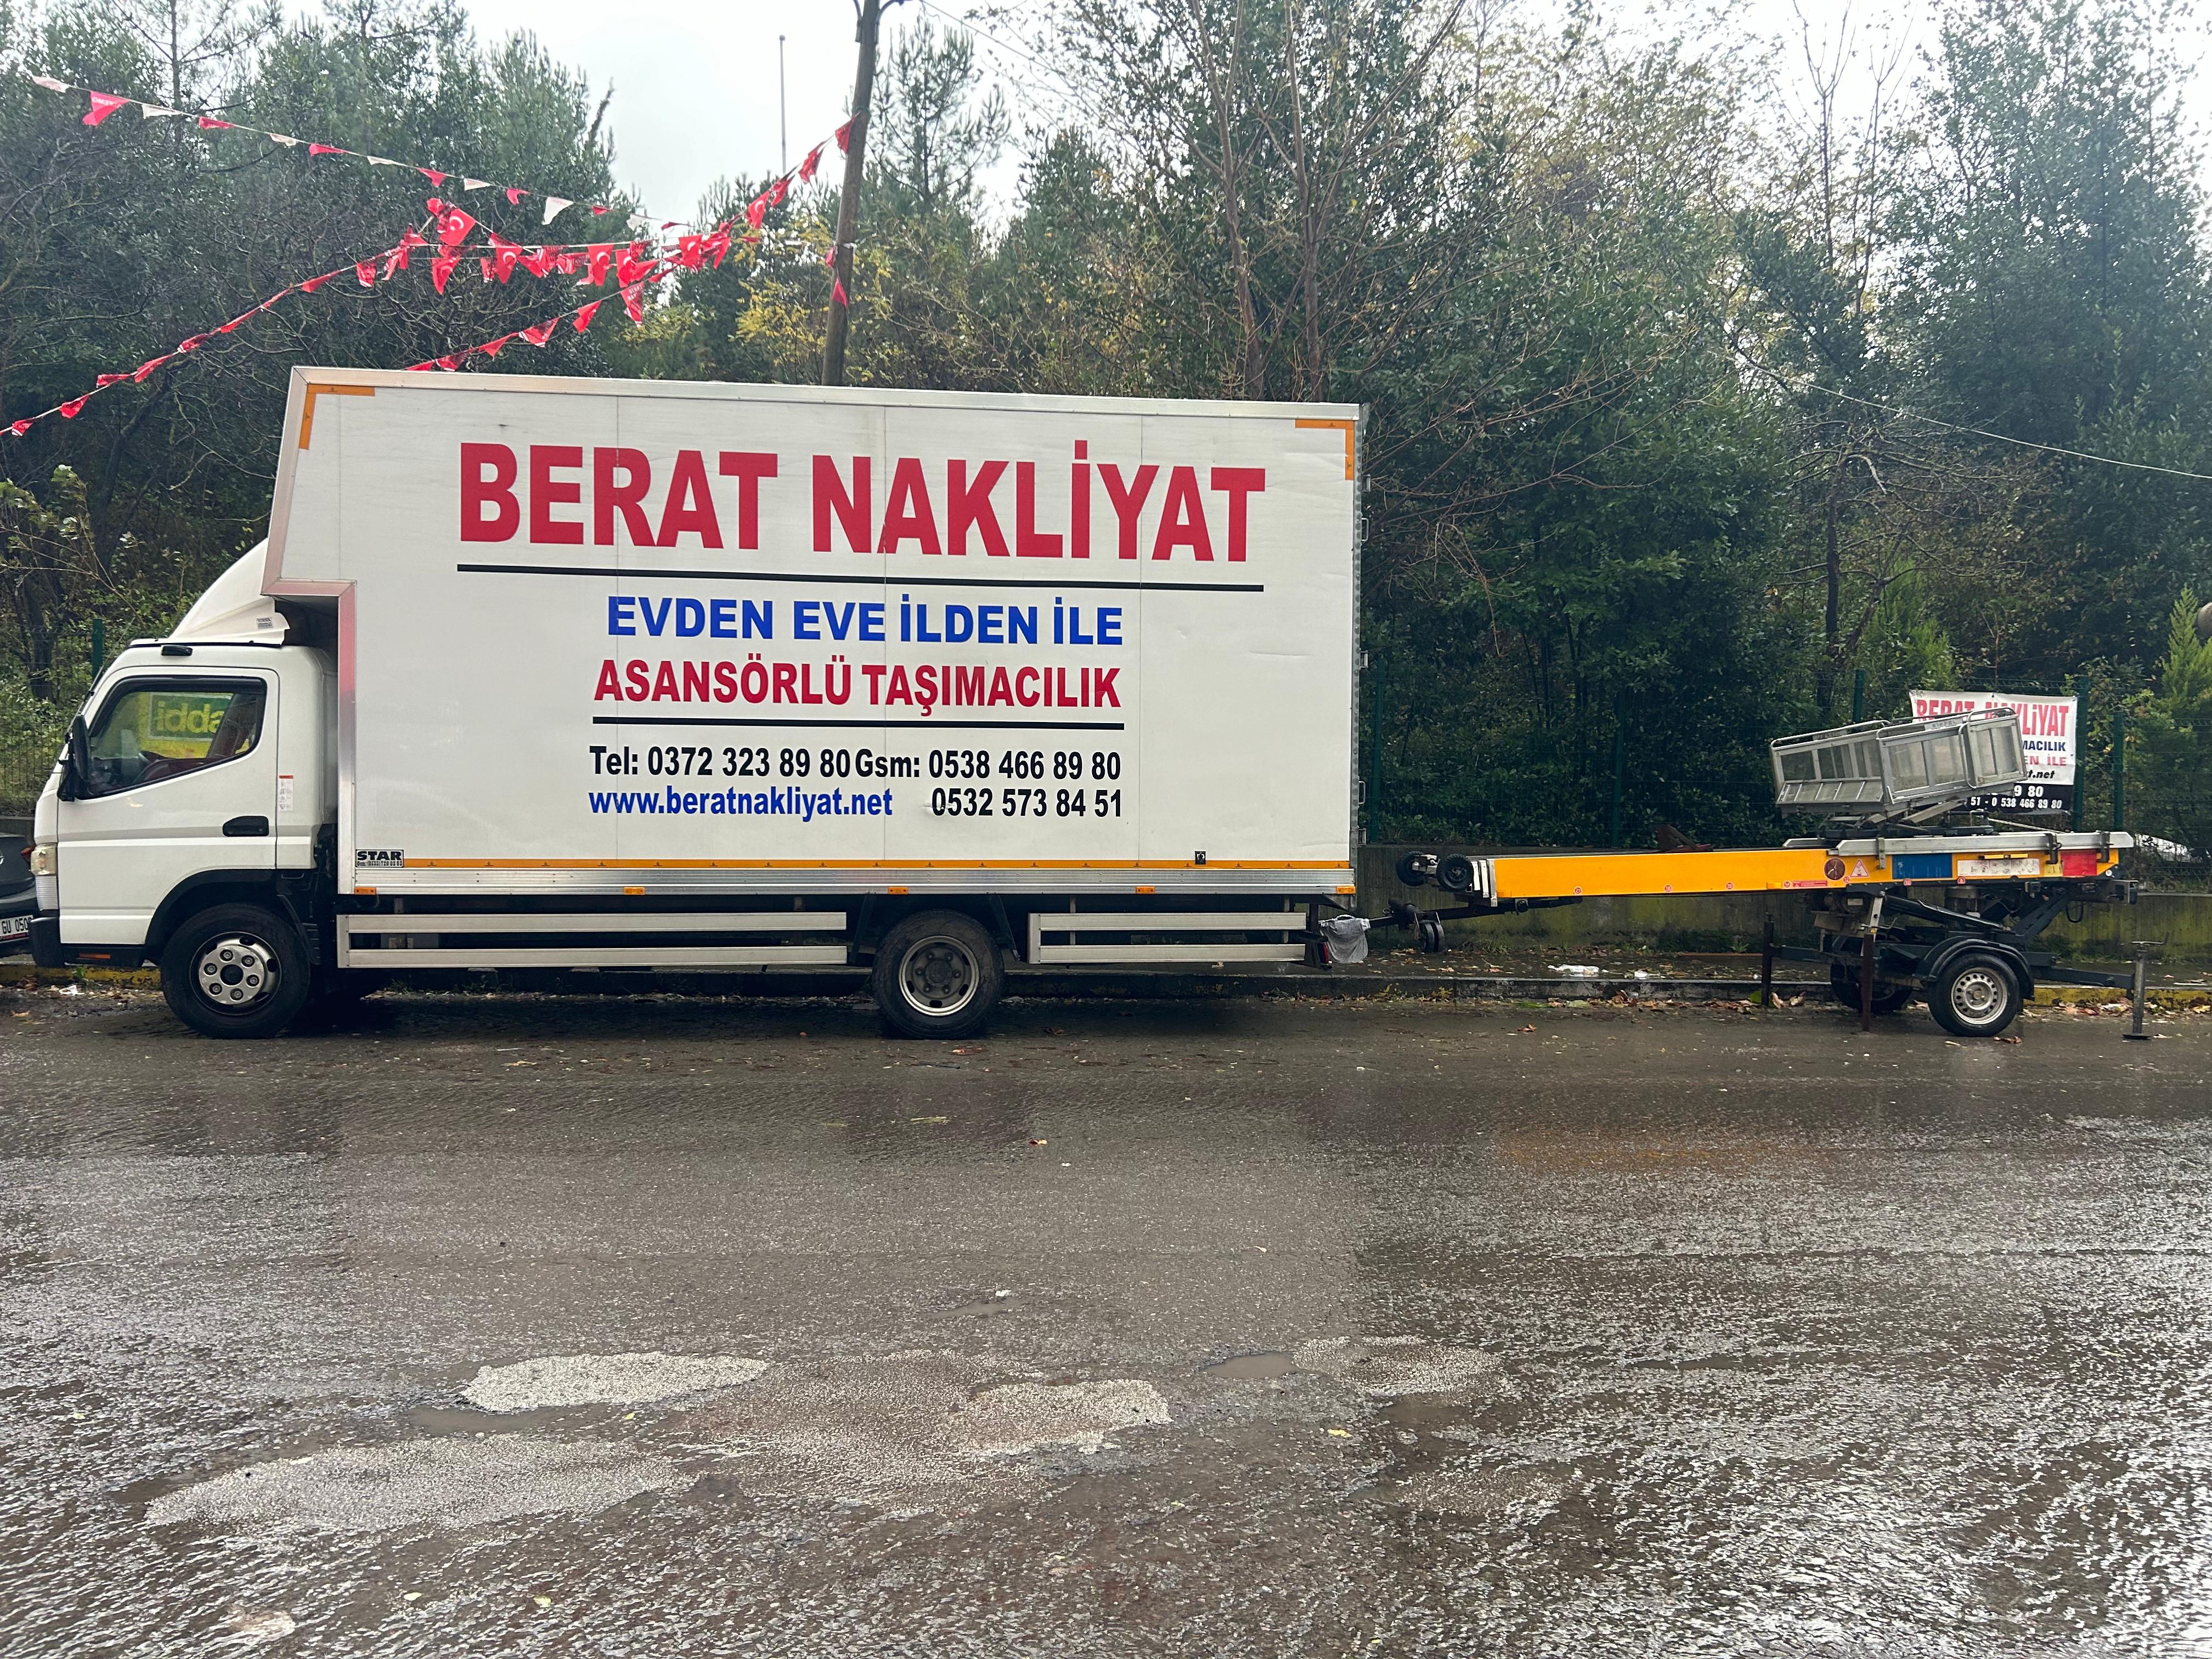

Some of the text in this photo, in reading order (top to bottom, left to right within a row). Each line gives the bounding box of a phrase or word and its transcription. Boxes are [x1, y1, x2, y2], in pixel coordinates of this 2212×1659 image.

[460, 439, 1266, 562] BERAT NAKLİYAT
[608, 594, 1122, 645] EVDEN EVE İLDEN İLE
[594, 653, 1120, 717] ASANSÖRLÜ TAŞIMACILIK
[589, 746, 1121, 780] Tel: 0372 323 89 80 Gsm: 0538 466 89 80
[2027, 770, 2055, 778] t.net
[589, 786, 893, 822] www.beratnakliyat.net
[931, 787, 1121, 817] 0532 573 84 51
[1971, 797, 1980, 806] 51
[1991, 797, 1997, 806] 0
[2001, 798, 2017, 808] 538
[2019, 799, 2034, 808] 466
[2038, 799, 2048, 809] 89
[2051, 800, 2062, 809] 80
[2028, 786, 2044, 797] 80
[357, 851, 402, 860] STAR
[2, 920, 11, 934] GU
